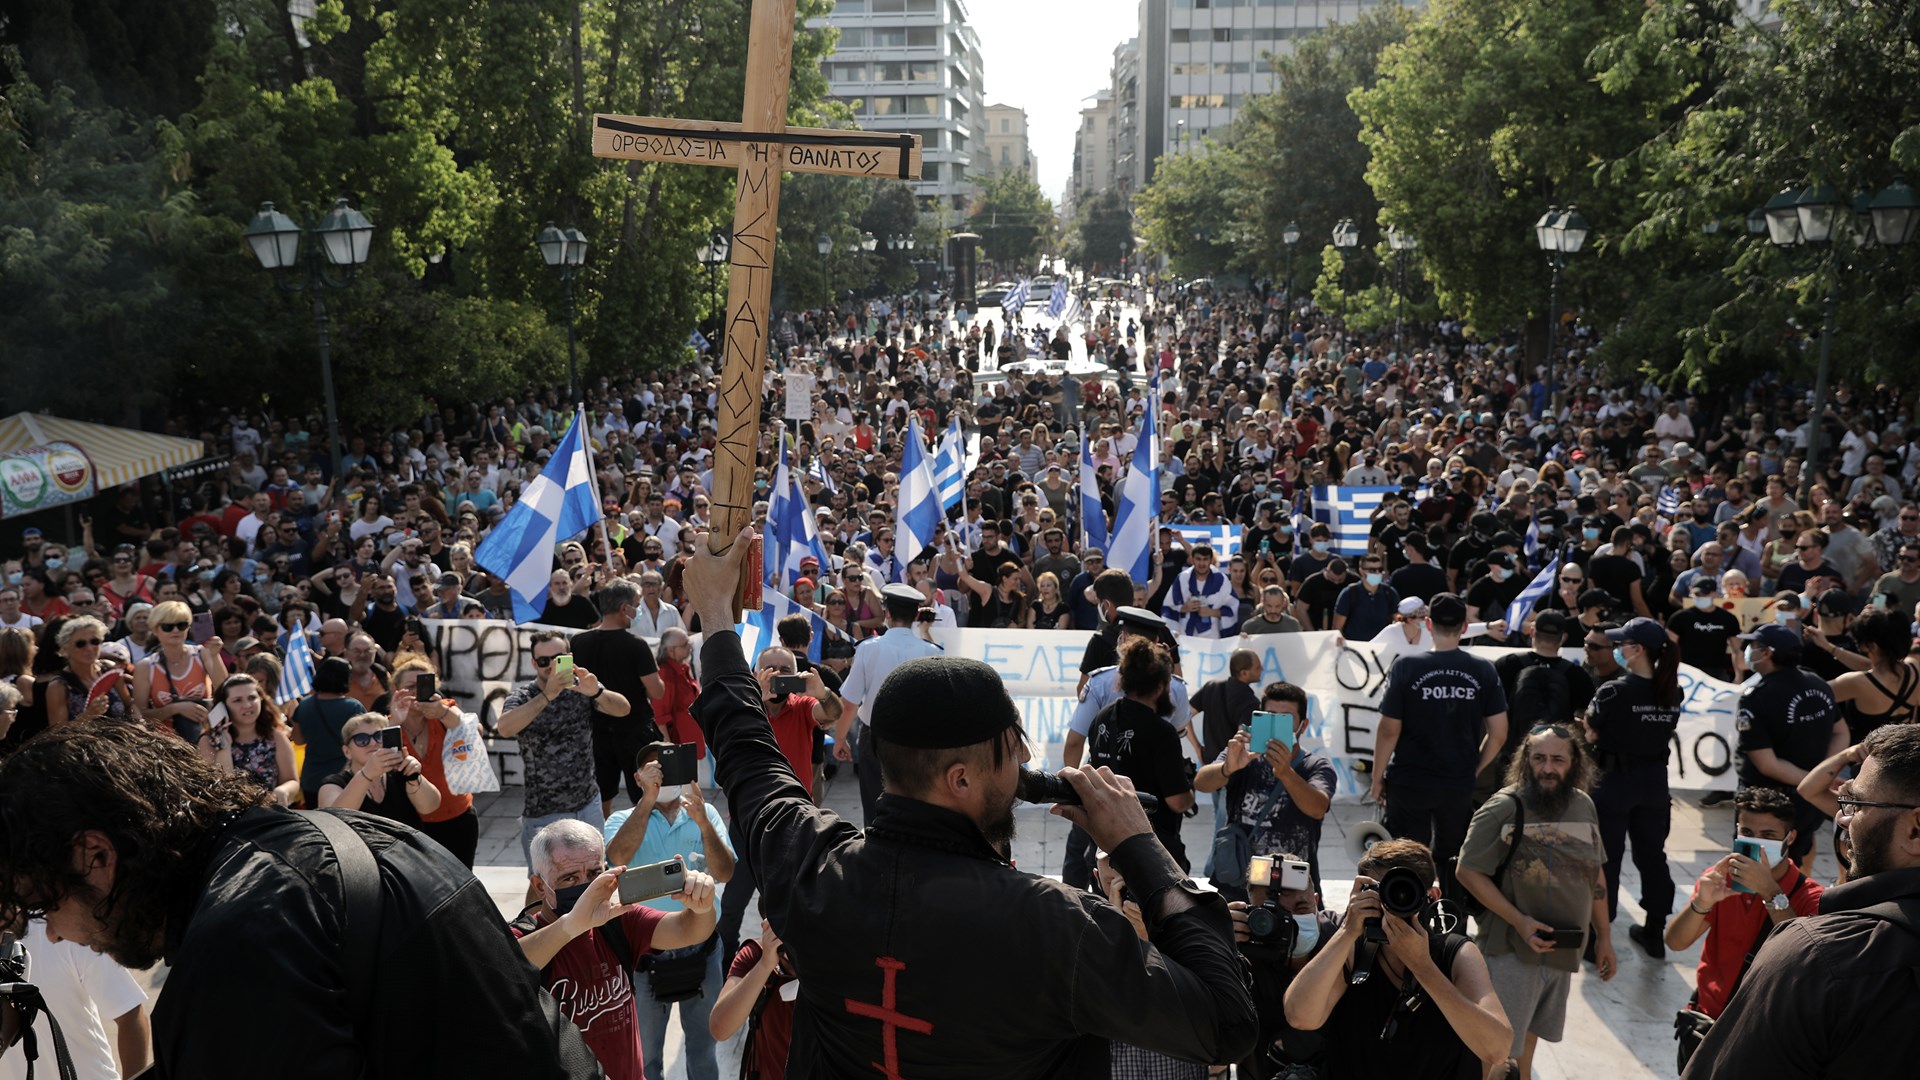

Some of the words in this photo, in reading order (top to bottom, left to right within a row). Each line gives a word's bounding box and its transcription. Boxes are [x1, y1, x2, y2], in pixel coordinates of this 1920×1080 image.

[713, 166, 771, 537] ΜΕΤΑΝΟΕΙΤ
[1422, 686, 1475, 700] POLICE
[1641, 714, 1673, 722] POLICE
